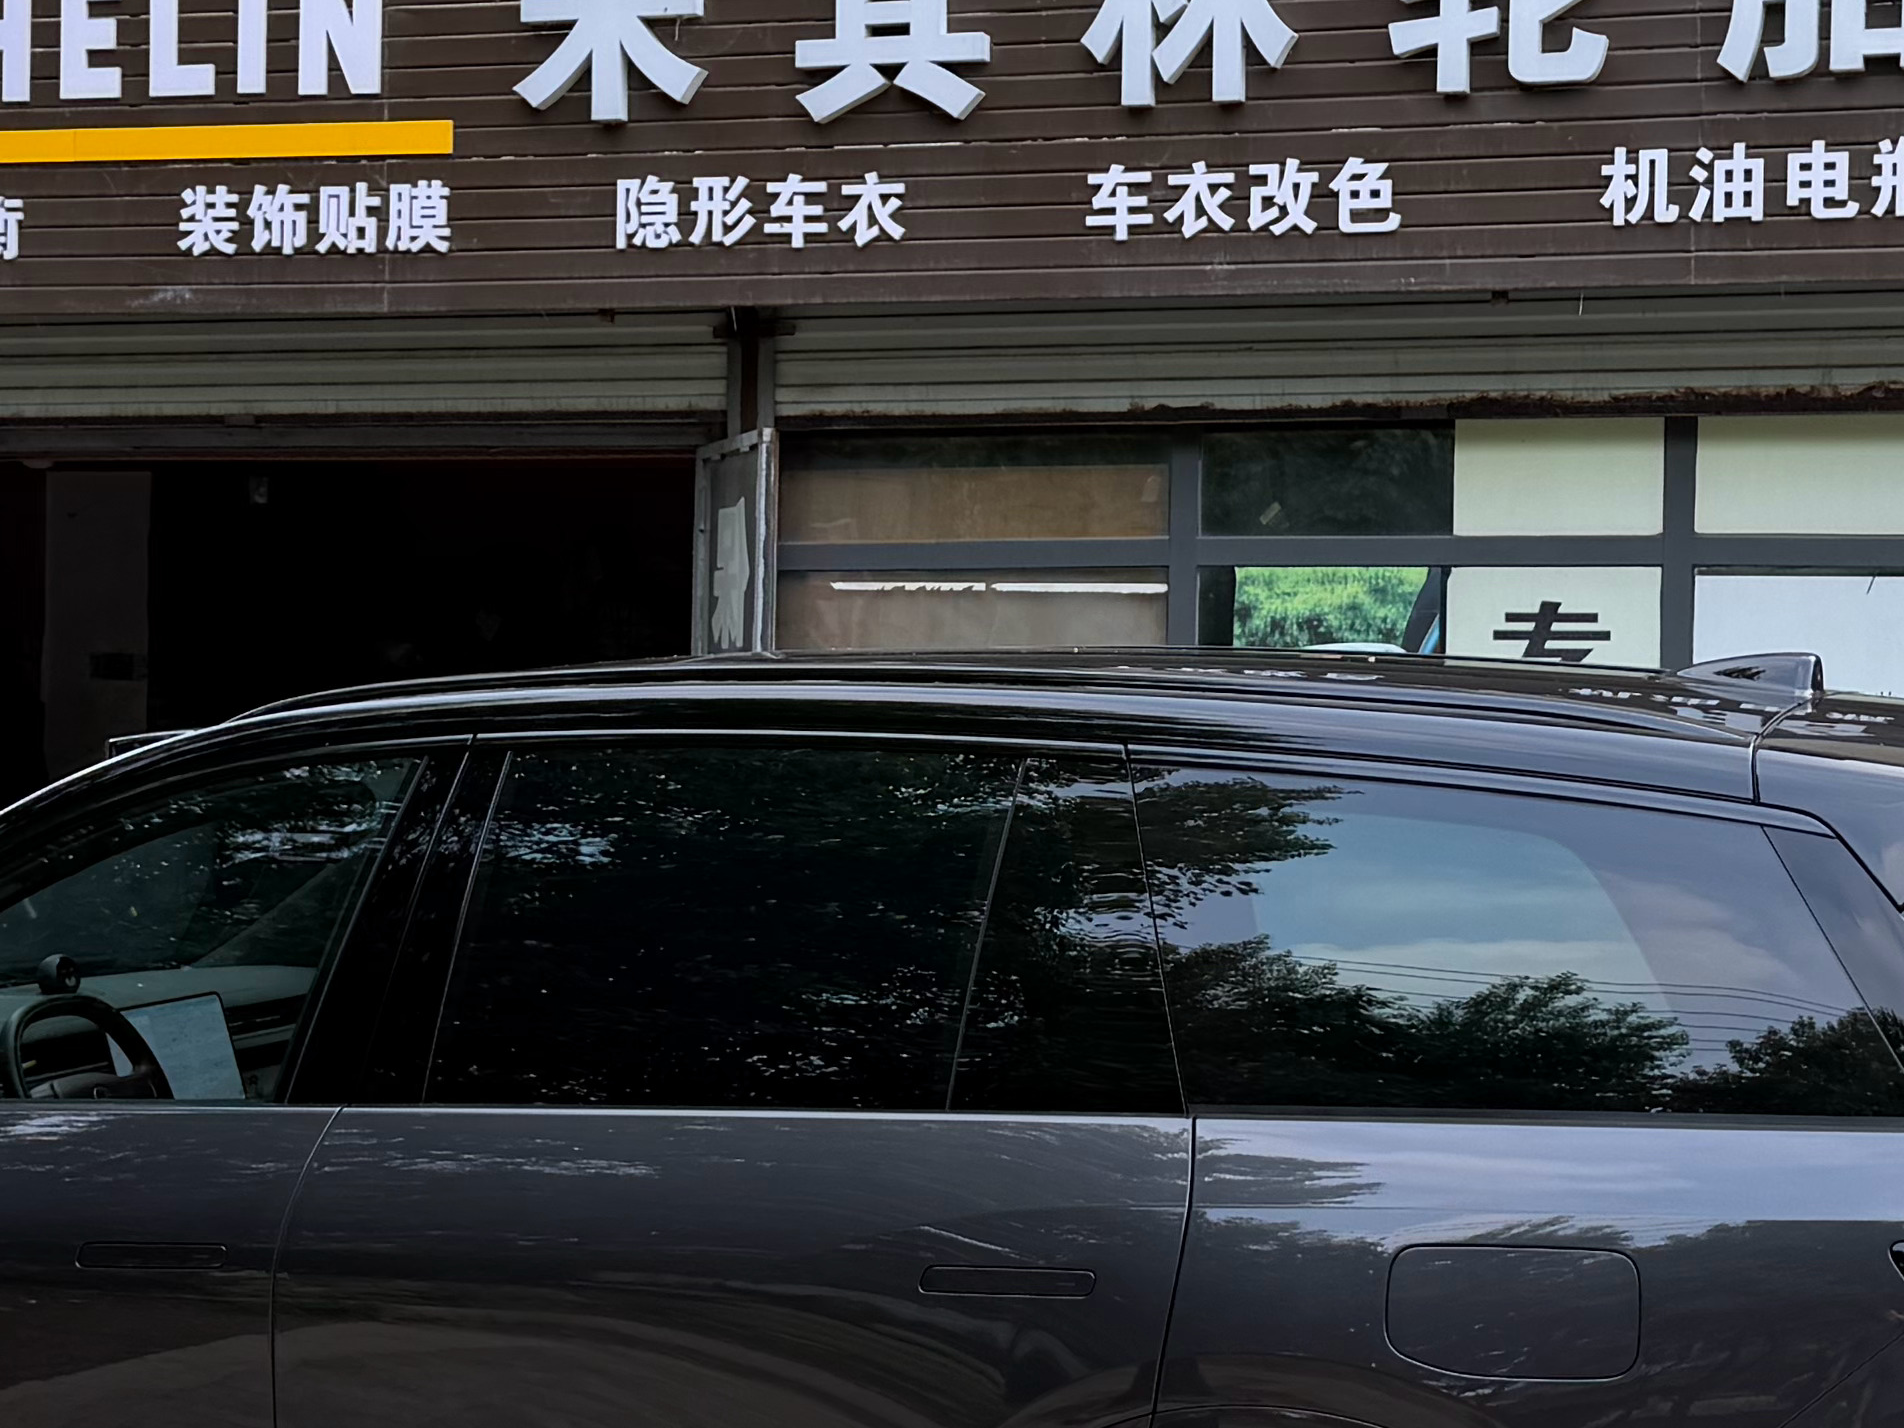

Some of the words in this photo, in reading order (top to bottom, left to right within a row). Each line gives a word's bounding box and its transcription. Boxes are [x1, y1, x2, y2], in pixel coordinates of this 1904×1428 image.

[177, 180, 453, 256] 装饰贴膜
[613, 174, 908, 251] 隐形车衣
[1084, 156, 1404, 243] 车衣改色
